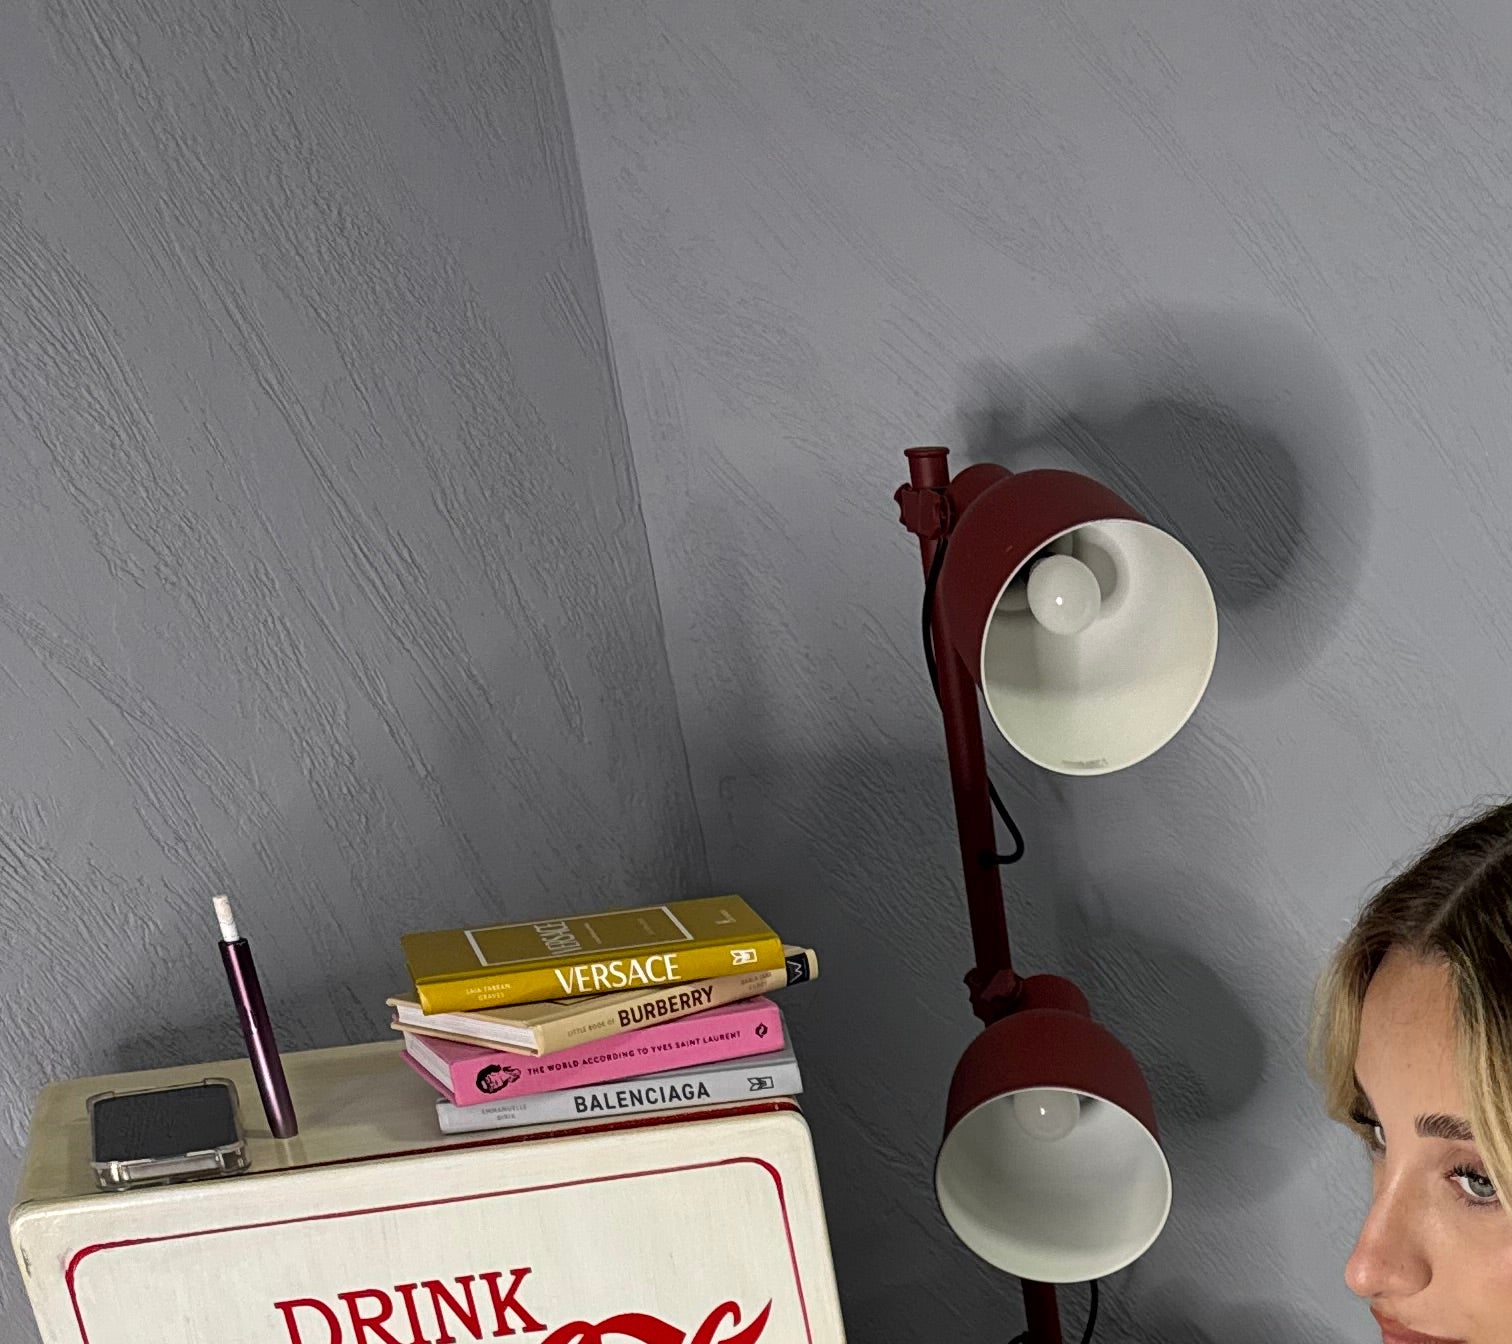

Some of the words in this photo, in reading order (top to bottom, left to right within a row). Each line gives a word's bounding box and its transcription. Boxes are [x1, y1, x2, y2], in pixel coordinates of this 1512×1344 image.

[553, 953, 682, 995] VERSACE
[618, 985, 713, 1028] BURBERRY
[527, 1065, 545, 1076] THE
[547, 1060, 579, 1073] WORLD
[582, 1050, 635, 1066] ACCORDING
[637, 1047, 648, 1055] TO
[650, 1042, 673, 1053] YVES
[675, 1038, 701, 1050] SAINT
[703, 1030, 741, 1044] LAURENT
[573, 1081, 711, 1114] BALENCIAGA
